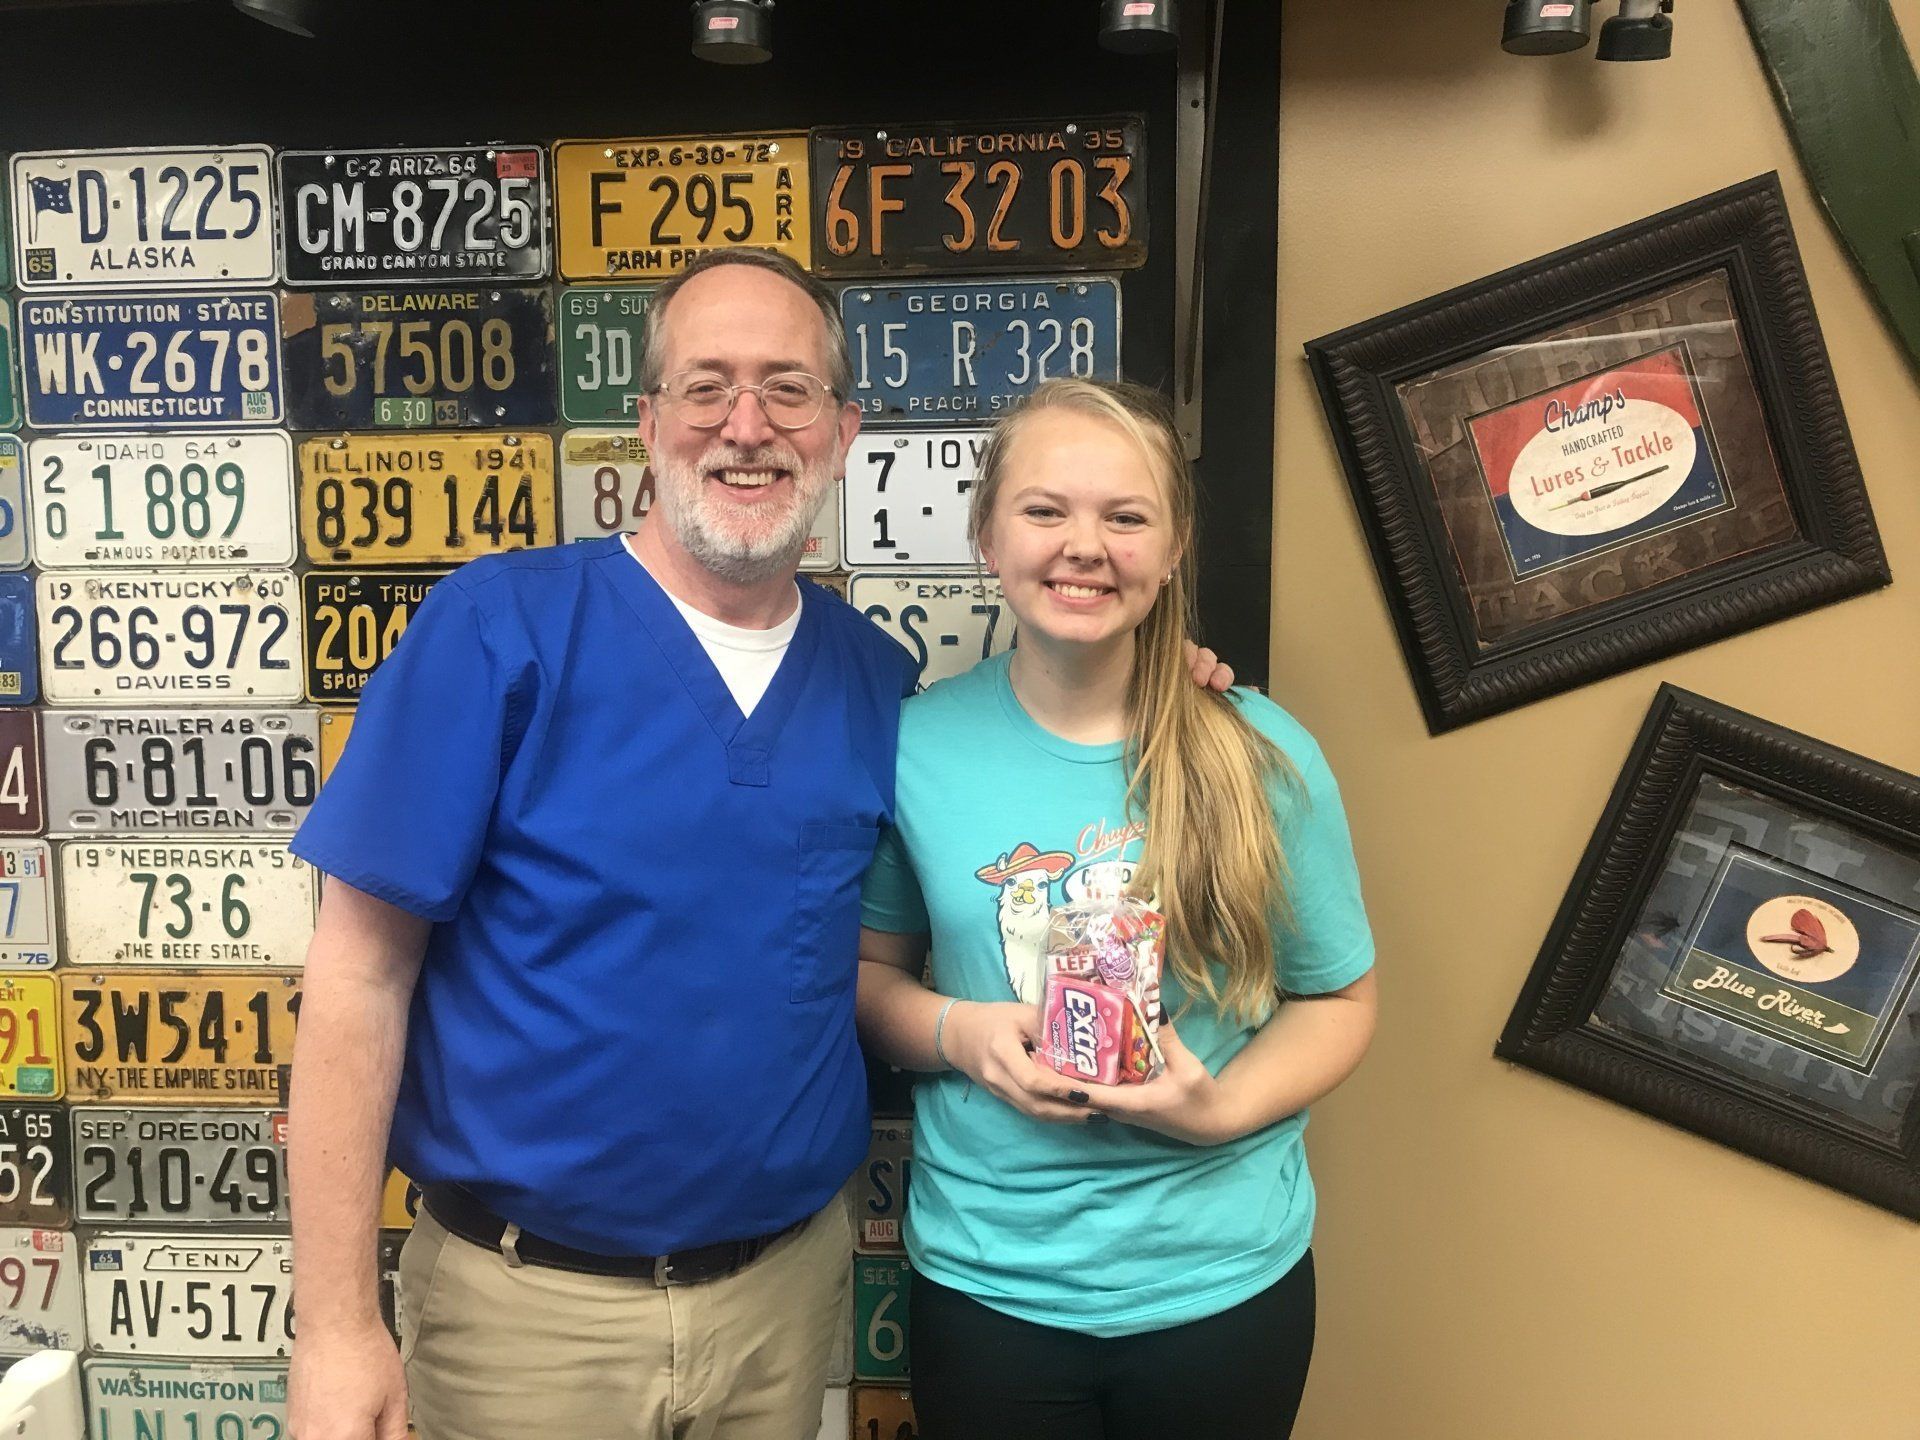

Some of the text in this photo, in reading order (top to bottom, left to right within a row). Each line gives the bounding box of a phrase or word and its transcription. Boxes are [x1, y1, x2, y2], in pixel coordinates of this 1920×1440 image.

[886, 131, 1065, 157] CALIFORNIA
[1083, 130, 1123, 148] 35
[346, 156, 476, 177] C-2 ARIZ. 64
[616, 149, 663, 168] EXP.
[297, 178, 532, 253] CM-8725
[649, 172, 754, 245] 295
[825, 164, 912, 256] 6F
[27, 256, 54, 273] 65
[90, 246, 195, 270] ALASKA
[321, 252, 506, 271] GRAND CANYON STATE
[607, 250, 662, 271] FARM
[362, 293, 480, 312] DELAWARE
[571, 299, 597, 315] 69
[908, 291, 1050, 312] GEORGIA
[29, 302, 268, 325] CONSTITUTION STATE
[322, 319, 516, 396] 57508
[856, 317, 1094, 389] 15 R 328
[83, 396, 225, 418] CONNECTICUT
[246, 392, 267, 407] AUG
[909, 396, 977, 411] PEACH
[247, 405, 267, 416] 1980
[1544, 387, 1626, 435] Champs
[97, 442, 218, 460] IDAHO 64
[1561, 425, 1624, 456] HANDCRAFTED
[314, 449, 536, 473] ILLINOIS 1941
[1530, 431, 1673, 497] Lures & Tackle
[316, 474, 537, 548] 839 144
[96, 545, 237, 560] FAMOUS POTATOES
[50, 581, 283, 600] 19 KENTUCKY 60
[117, 676, 230, 689] DAVIESS
[100, 719, 254, 735] TRAILER 48
[111, 810, 254, 827] MICHIGAN
[23, 860, 38, 875] 91
[75, 849, 99, 867] 19
[121, 849, 254, 867] NEBRASKA
[123, 943, 262, 959] THE BEEF STATE
[1693, 966, 1826, 1025] Blue River
[1052, 1021, 1060, 1048] CLASSIC
[1065, 988, 1099, 1078] Extra
[153, 1067, 221, 1090] EMPIRE
[225, 1068, 278, 1089] STATE
[25, 1114, 52, 1137] 65
[138, 1122, 260, 1141] OREGON
[868, 1221, 894, 1237] AUG
[168, 1252, 240, 1267] TENN
[863, 1267, 899, 1285] SEE
[867, 1290, 904, 1361] 6
[97, 1378, 254, 1401] WASHINGTON
